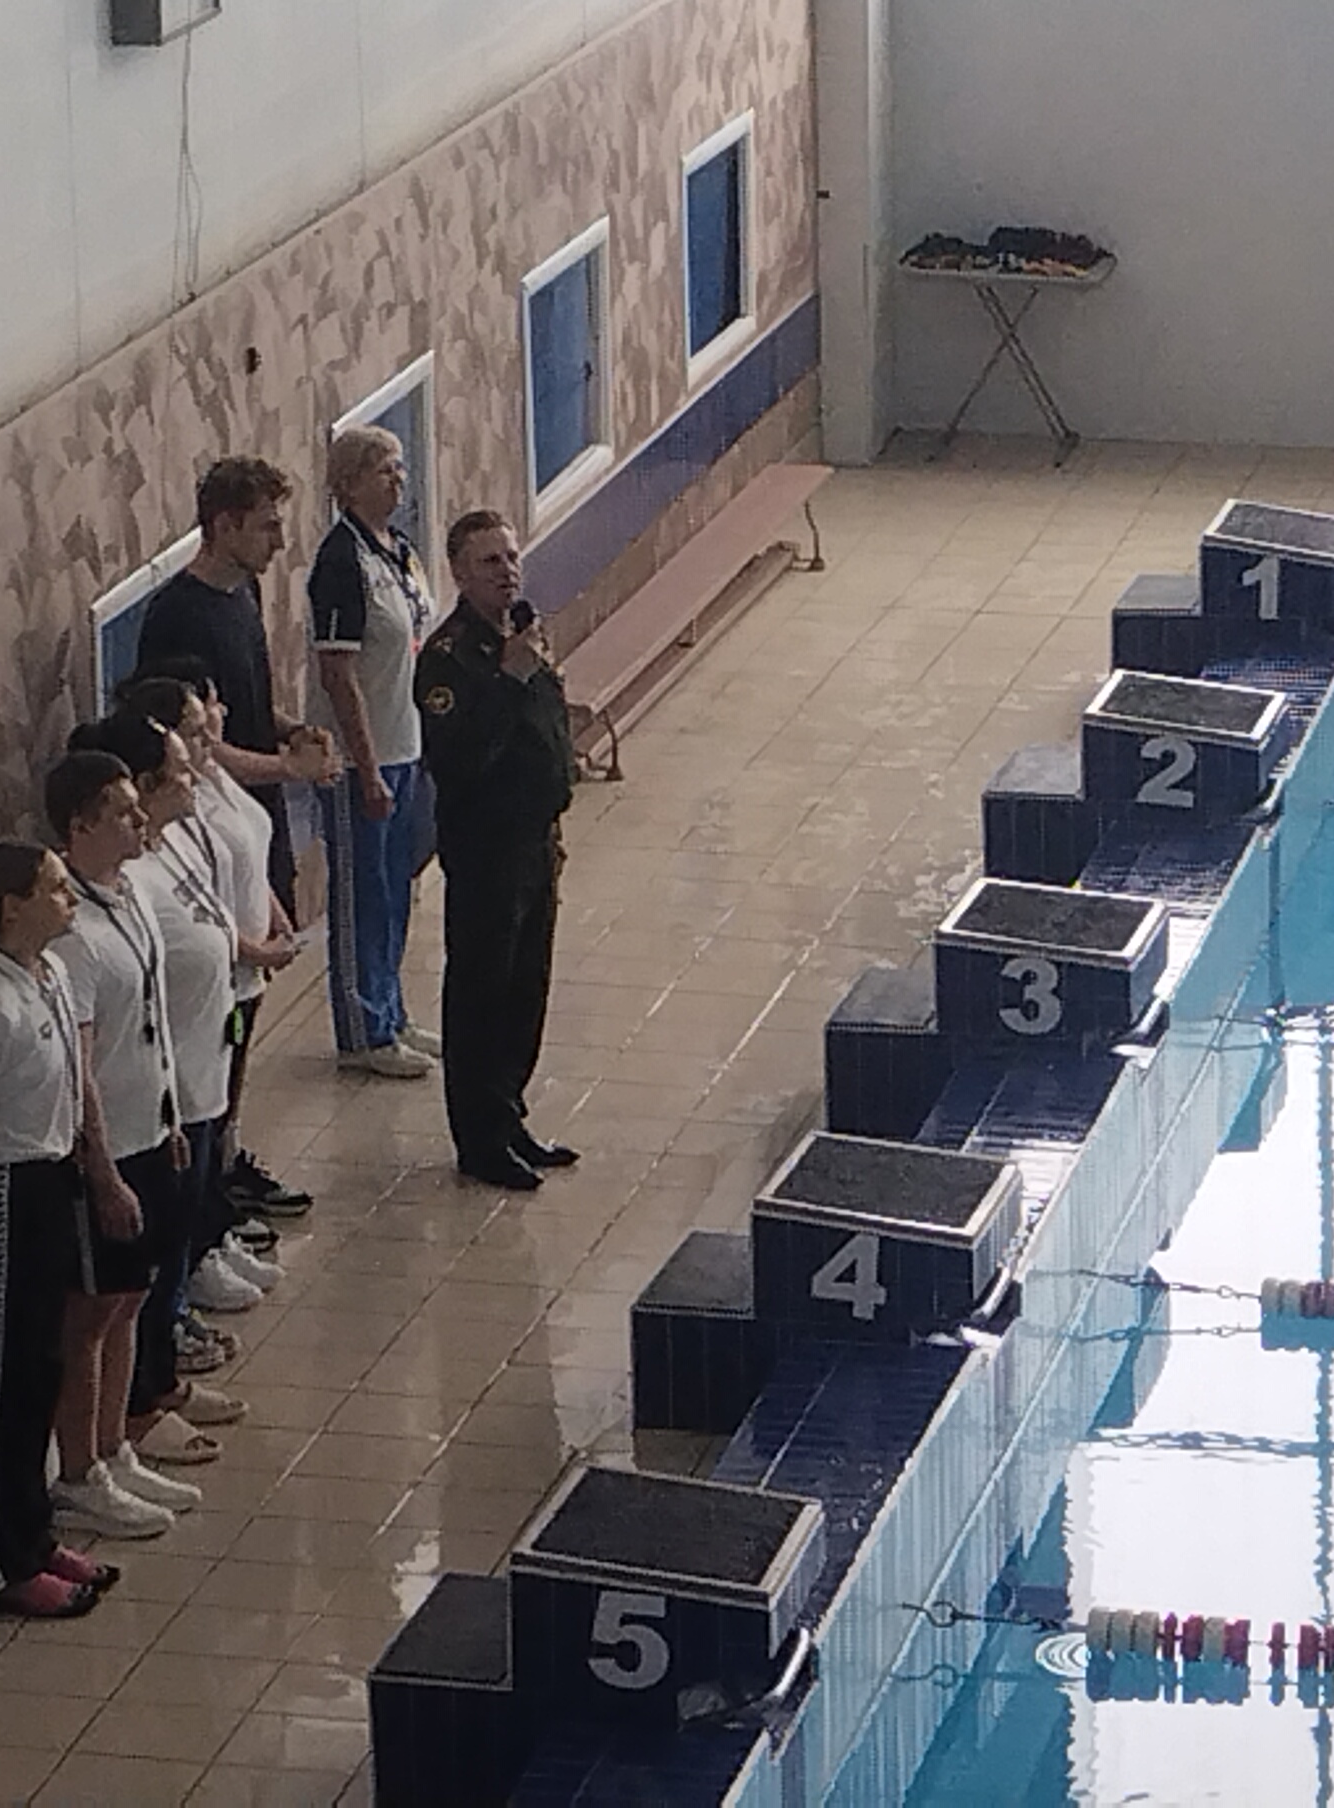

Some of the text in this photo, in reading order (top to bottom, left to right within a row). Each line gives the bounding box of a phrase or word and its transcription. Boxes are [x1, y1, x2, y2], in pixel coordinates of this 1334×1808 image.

[1242, 554, 1279, 620] 1
[1136, 734, 1196, 808] 2
[998, 957, 1062, 1035] 3
[811, 1231, 887, 1320] 4
[588, 1590, 670, 1689] 5
